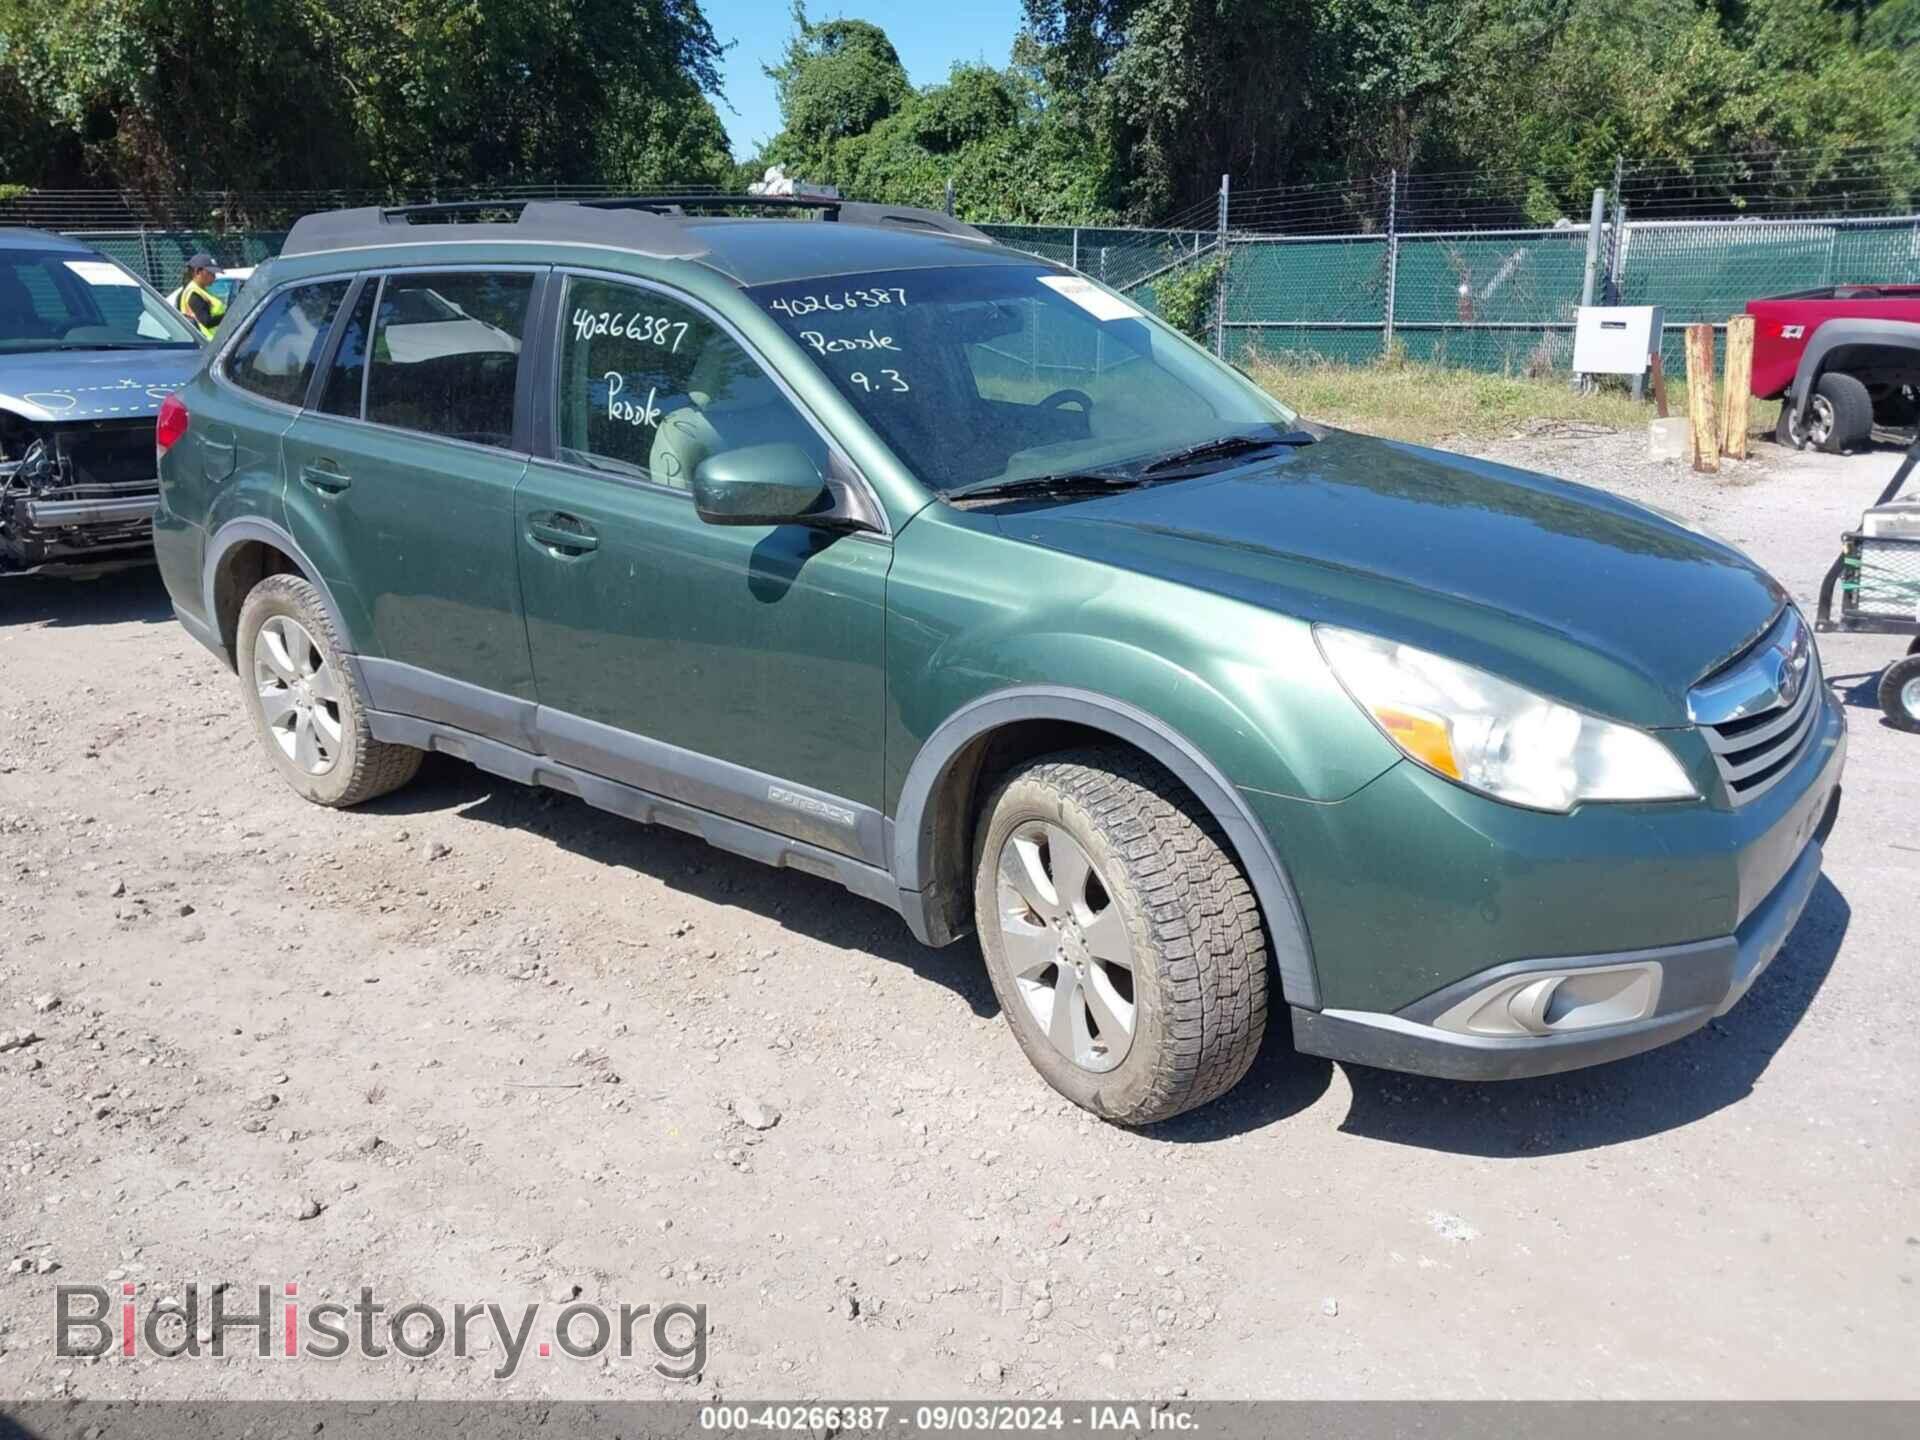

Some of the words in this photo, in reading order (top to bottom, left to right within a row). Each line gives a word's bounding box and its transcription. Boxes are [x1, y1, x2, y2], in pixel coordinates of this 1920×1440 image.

[771, 287, 907, 317] 40266387
[573, 308, 688, 354] 40266387
[850, 369, 910, 393] 9.3
